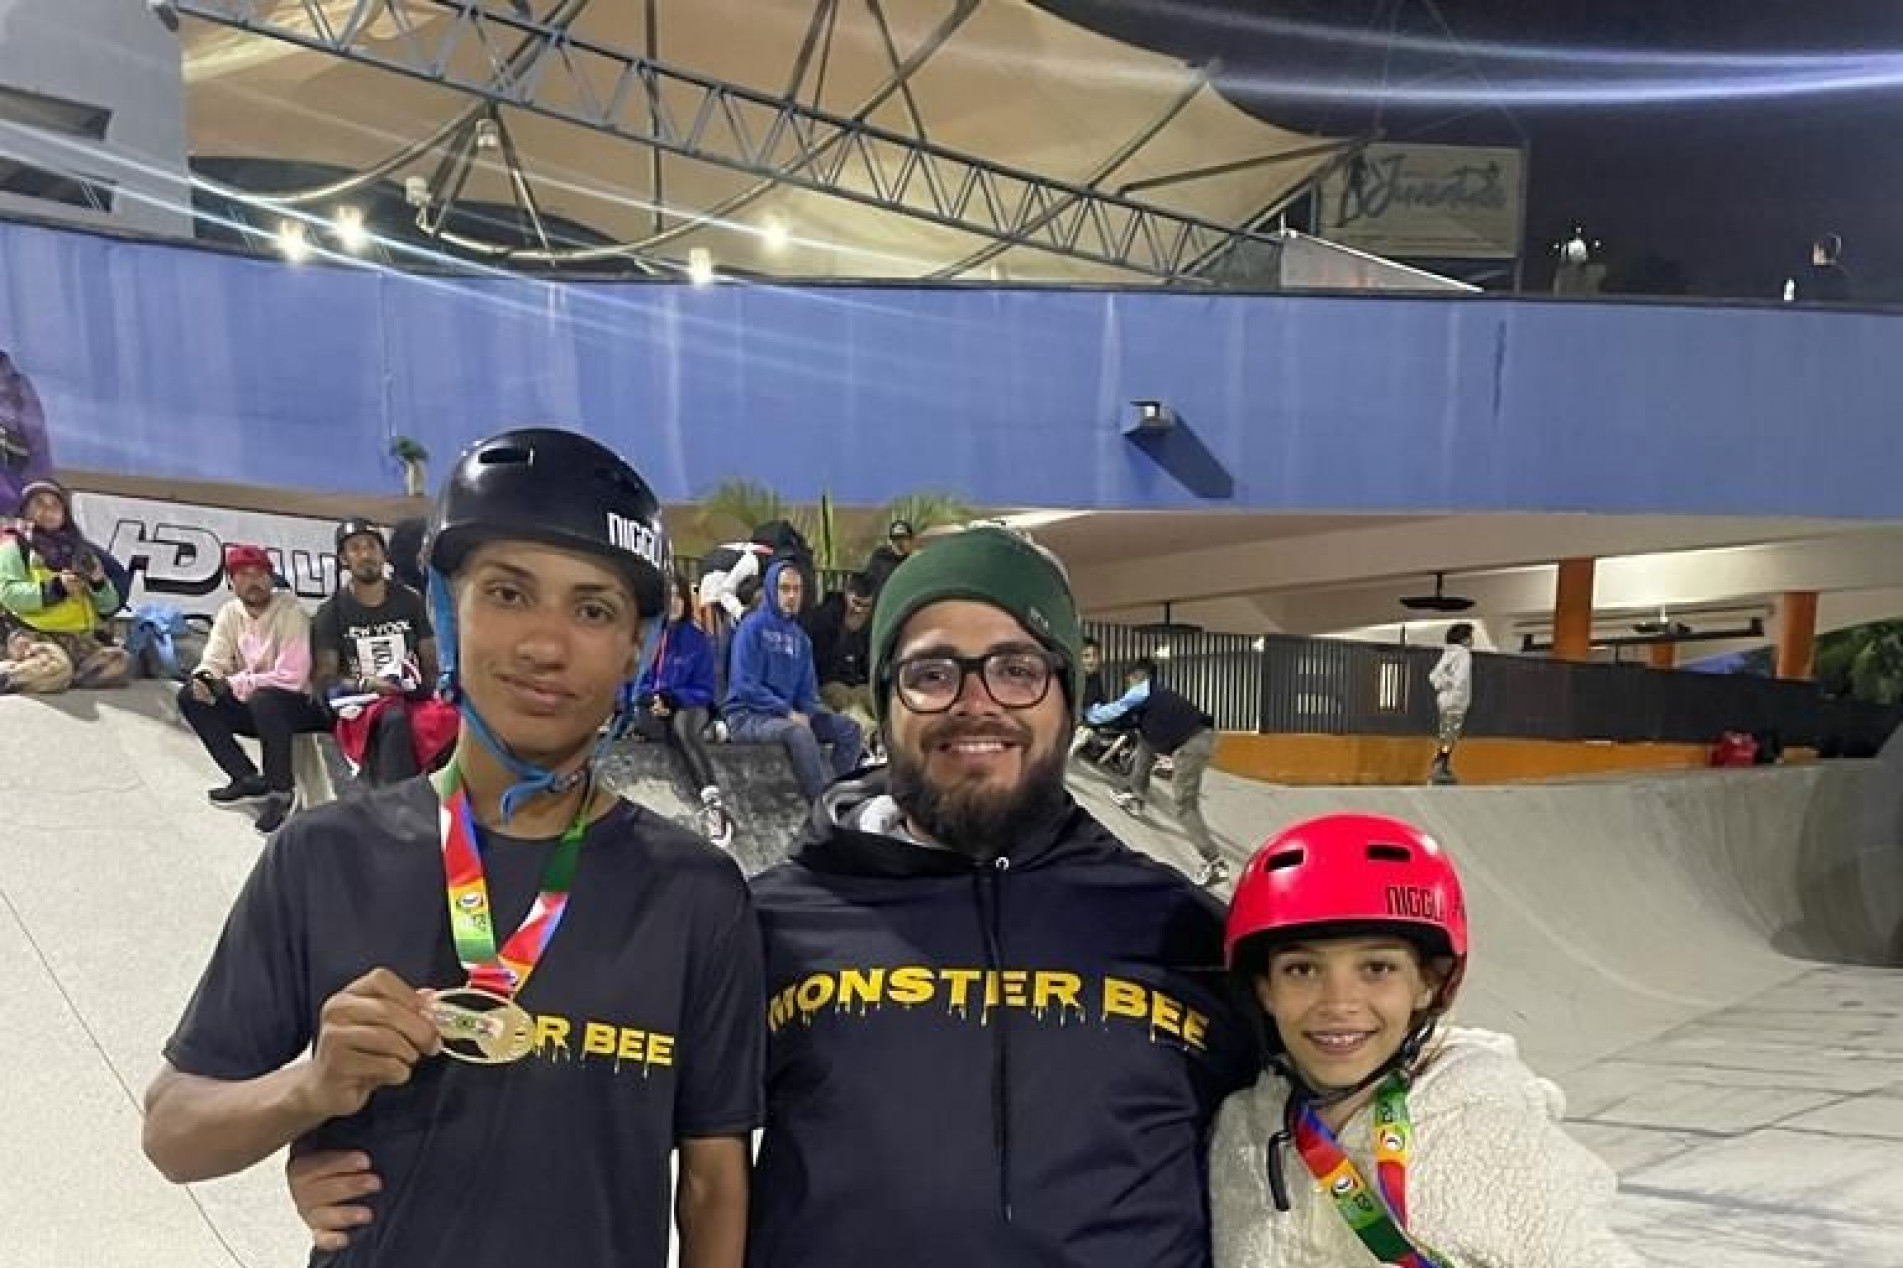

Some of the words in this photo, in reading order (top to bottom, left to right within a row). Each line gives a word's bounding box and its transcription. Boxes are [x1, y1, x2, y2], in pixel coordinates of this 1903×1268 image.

[768, 966, 1086, 1034] MONSTER
[1103, 977, 1210, 1048] BEE
[583, 1021, 676, 1072] BEE
